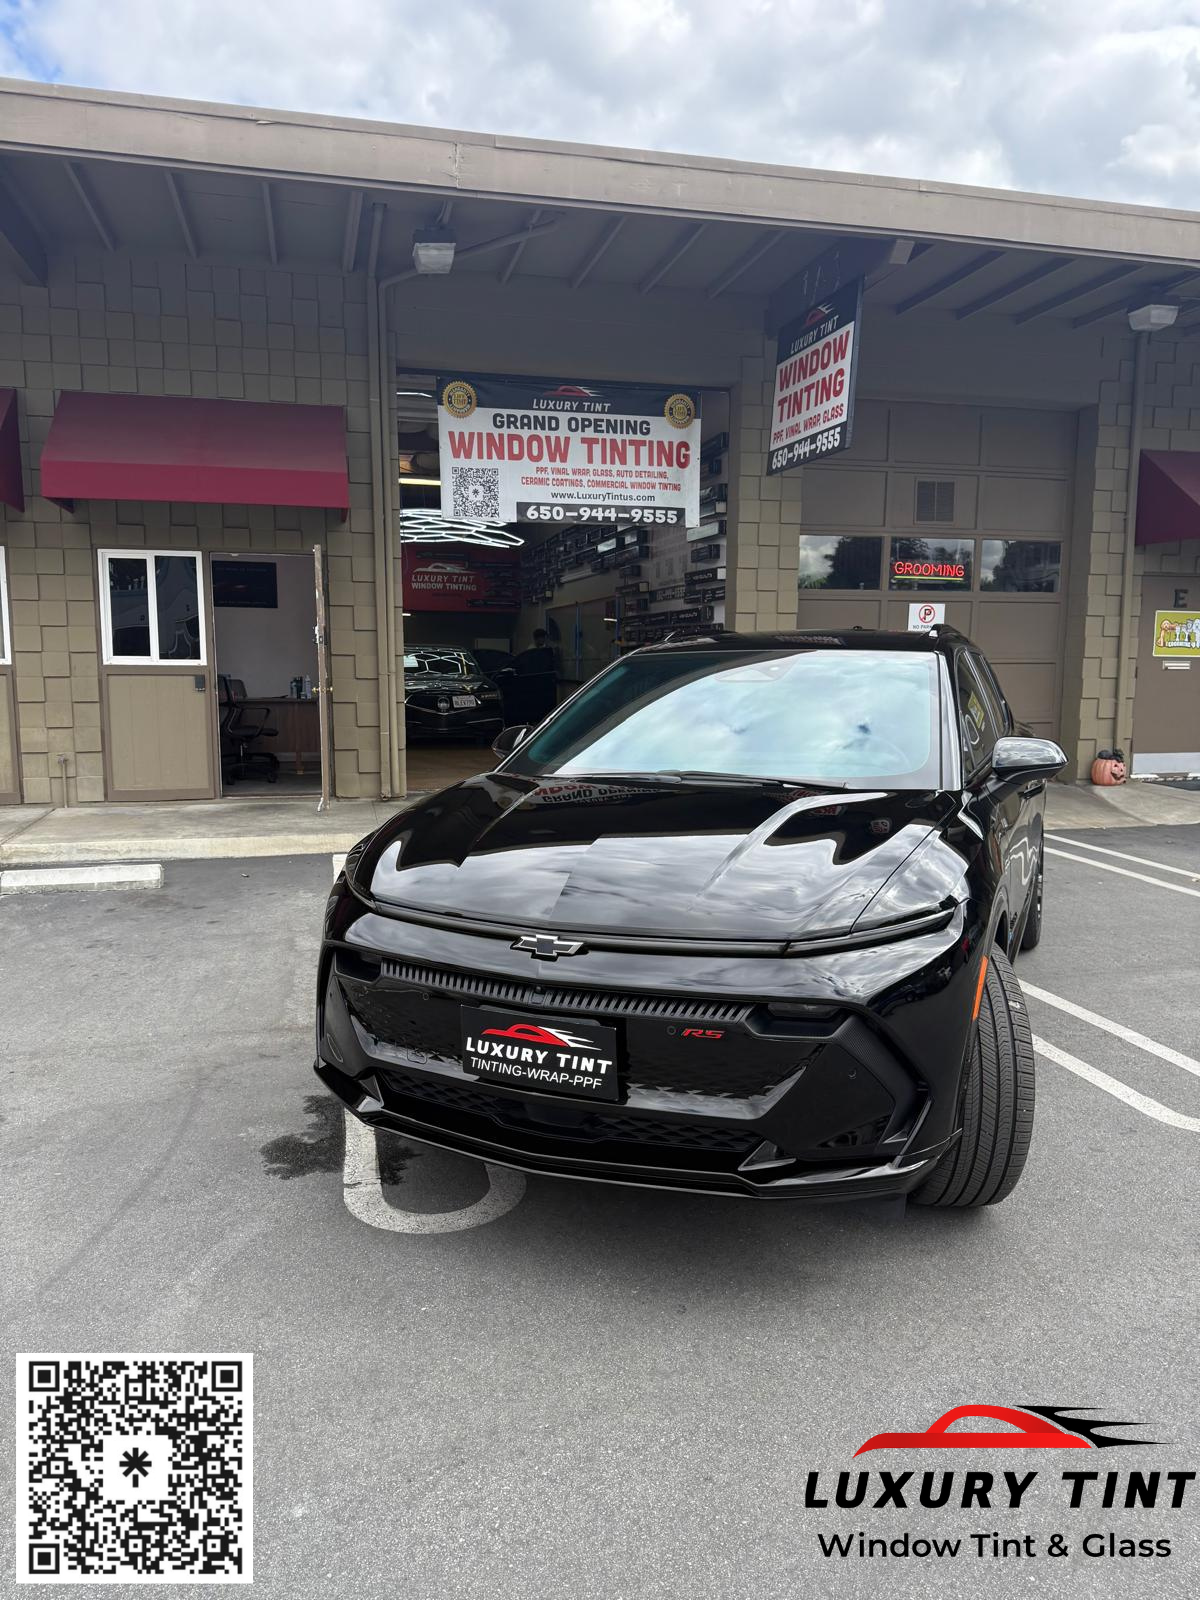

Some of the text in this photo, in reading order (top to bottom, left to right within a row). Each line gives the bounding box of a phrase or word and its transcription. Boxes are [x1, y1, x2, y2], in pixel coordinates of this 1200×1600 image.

[790, 315, 839, 355] LUXURY TINT
[779, 329, 851, 393] WINDOW
[532, 398, 611, 413] LUXURY TINT
[777, 367, 845, 424] TINTING
[823, 403, 844, 424] GLASS
[492, 413, 651, 436] GRAND OPENING
[448, 430, 691, 470] WINDOW TINTING
[771, 426, 841, 470] 650-944-9555
[551, 466, 570, 476] VINAL
[592, 468, 615, 478] GLASS,
[616, 470, 633, 479] AUTO
[634, 470, 669, 481] DETAILING,
[521, 476, 681, 492] CERAMIC COATINGS, COMMERCIAL WINDOW TINTING
[550, 491, 656, 502] www.LuxuryTintus.com
[526, 505, 678, 524] 650-944-9555
[411, 574, 476, 583] LUXURY TINT
[894, 561, 965, 577] GROOMING
[411, 582, 477, 591] WINDOW TINTING
[1173, 588, 1188, 608] E
[681, 1027, 726, 1040] RS
[465, 1036, 613, 1074] LUXURY TINT
[470, 1056, 603, 1090] TINTING-WRAP-PPF
